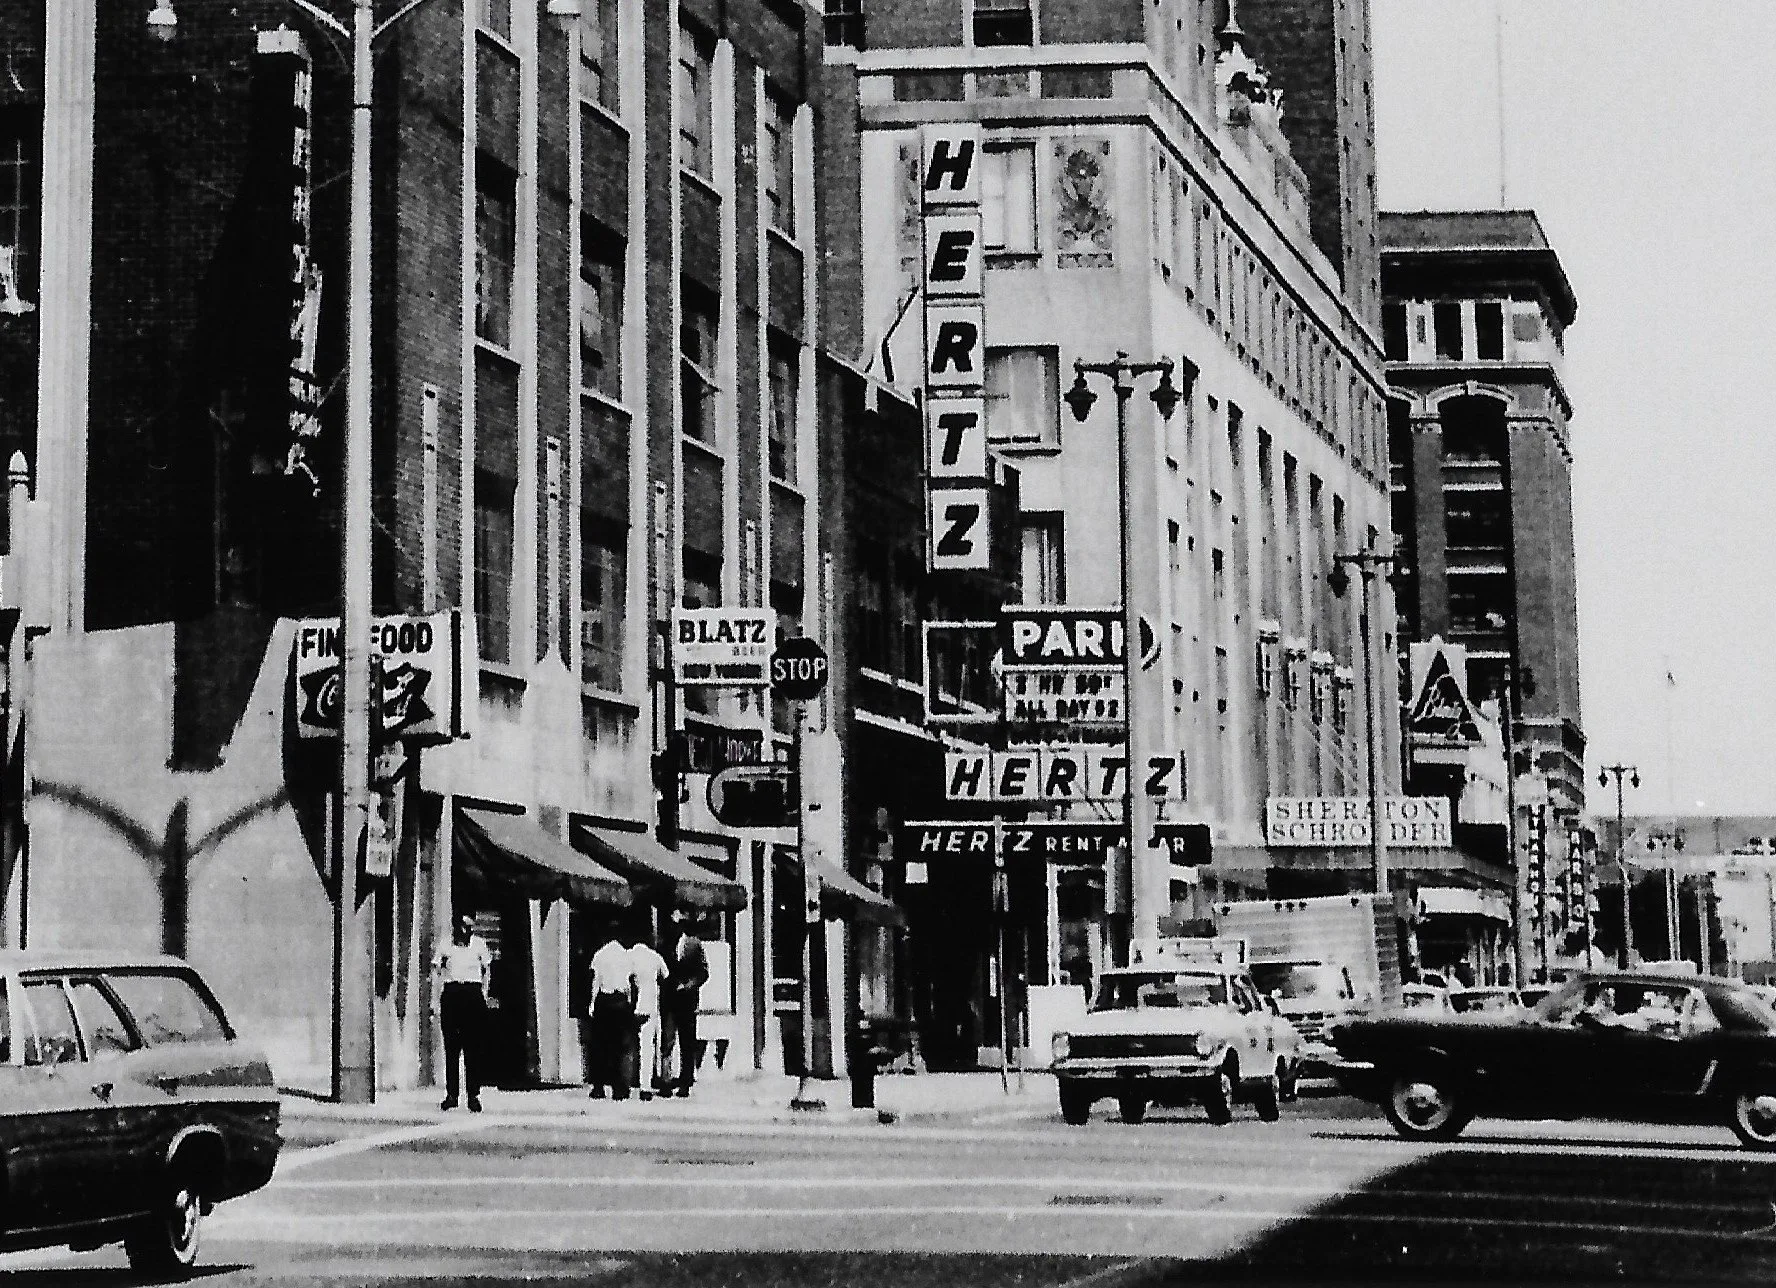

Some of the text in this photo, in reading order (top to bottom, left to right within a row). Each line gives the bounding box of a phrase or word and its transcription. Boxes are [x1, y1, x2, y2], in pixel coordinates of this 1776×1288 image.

[925, 139, 980, 557] HERTZ
[301, 627, 346, 658] FIN
[679, 620, 766, 643] BLATZ
[774, 657, 826, 681] STOP
[949, 756, 1176, 796] HERTZ
[1272, 822, 1446, 841] SCHRODER
[1046, 836, 1103, 852] RENT
[1158, 837, 1186, 853] AR
